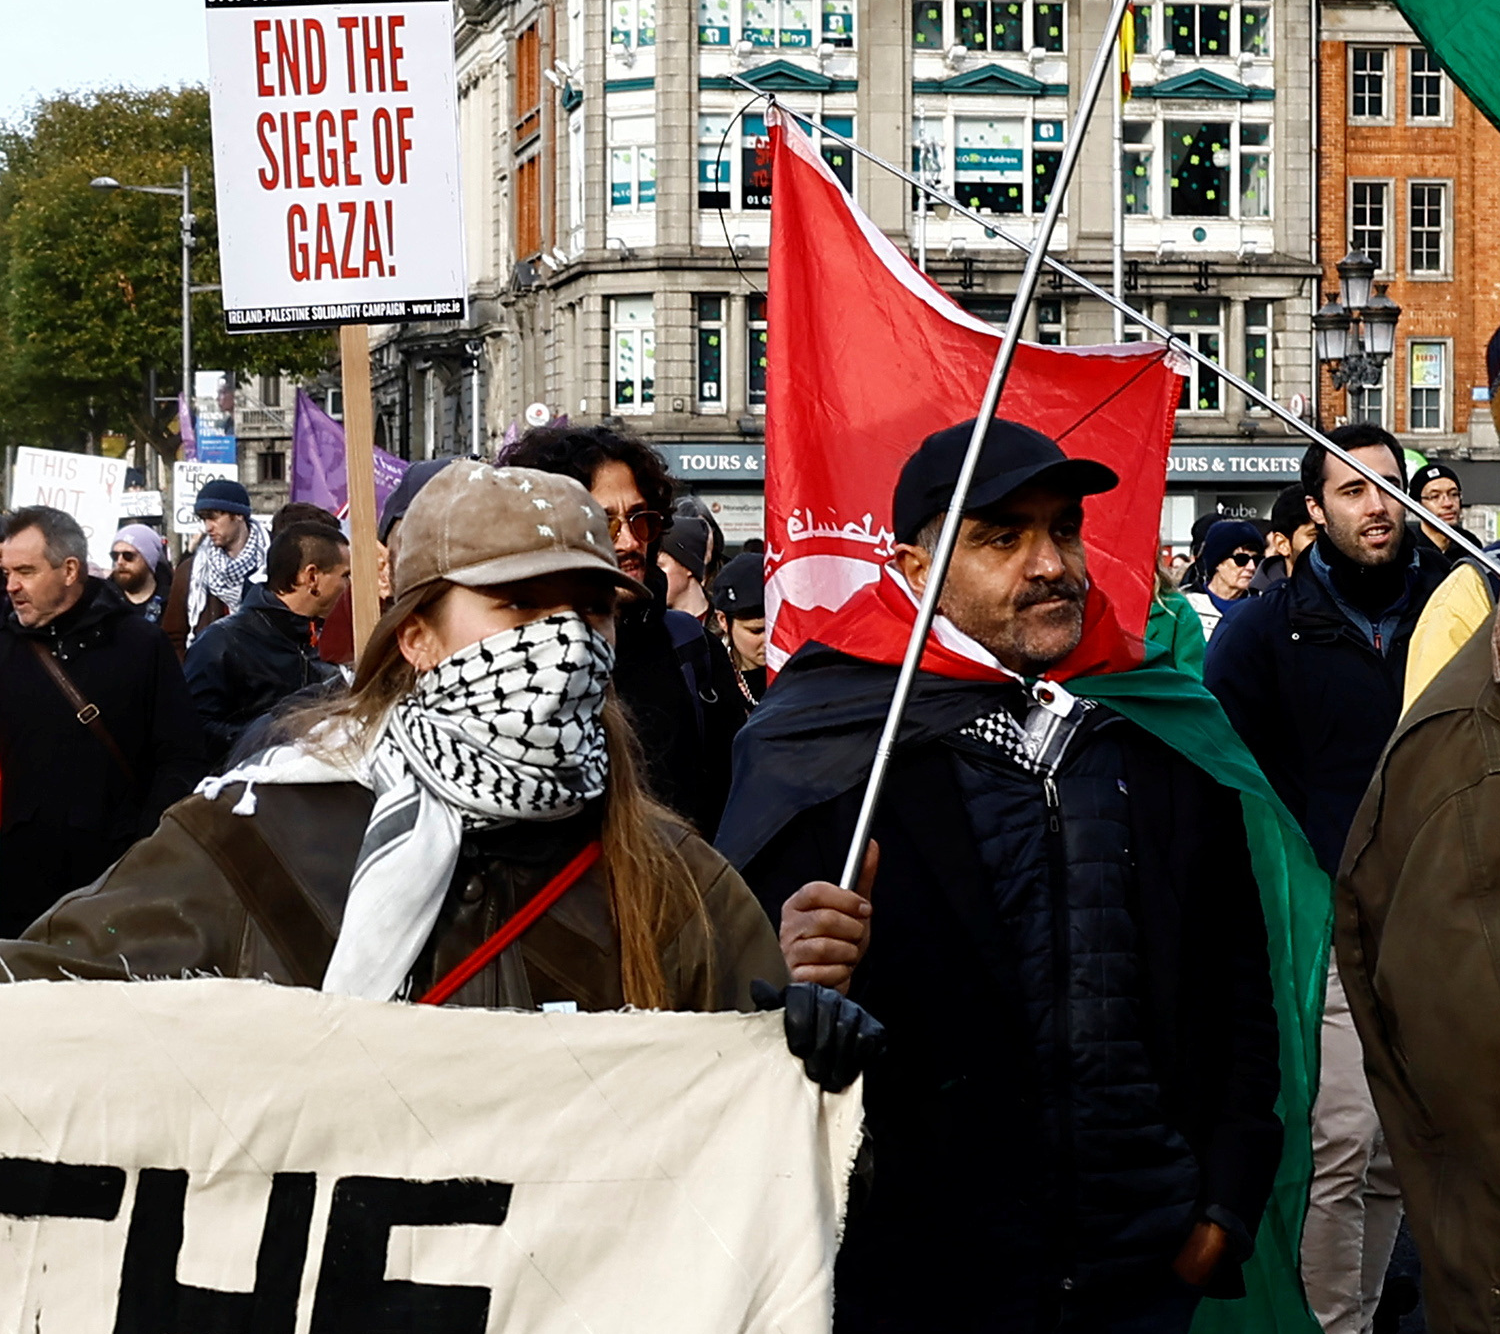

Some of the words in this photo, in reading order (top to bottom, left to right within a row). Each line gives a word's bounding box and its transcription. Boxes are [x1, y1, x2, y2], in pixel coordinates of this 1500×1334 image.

[253, 18, 327, 97] END
[337, 15, 409, 94] THE
[256, 108, 362, 191] SIEGE
[372, 107, 414, 186] OF
[286, 199, 397, 282] GAZA!
[228, 307, 310, 324] IRELAND-PALESTINE
[311, 304, 360, 320] SOLIDARITY
[362, 302, 405, 318] CAMPAIGN
[412, 299, 461, 317] www.ipsc.ie
[25, 452, 78, 481] THIS
[99, 462, 118, 487] IS
[680, 455, 740, 470] TOURS
[744, 455, 758, 470] &
[1165, 457, 1208, 472] OURS
[1211, 457, 1225, 472] &
[1228, 457, 1300, 472] TICKETS
[36, 486, 86, 517] NOT
